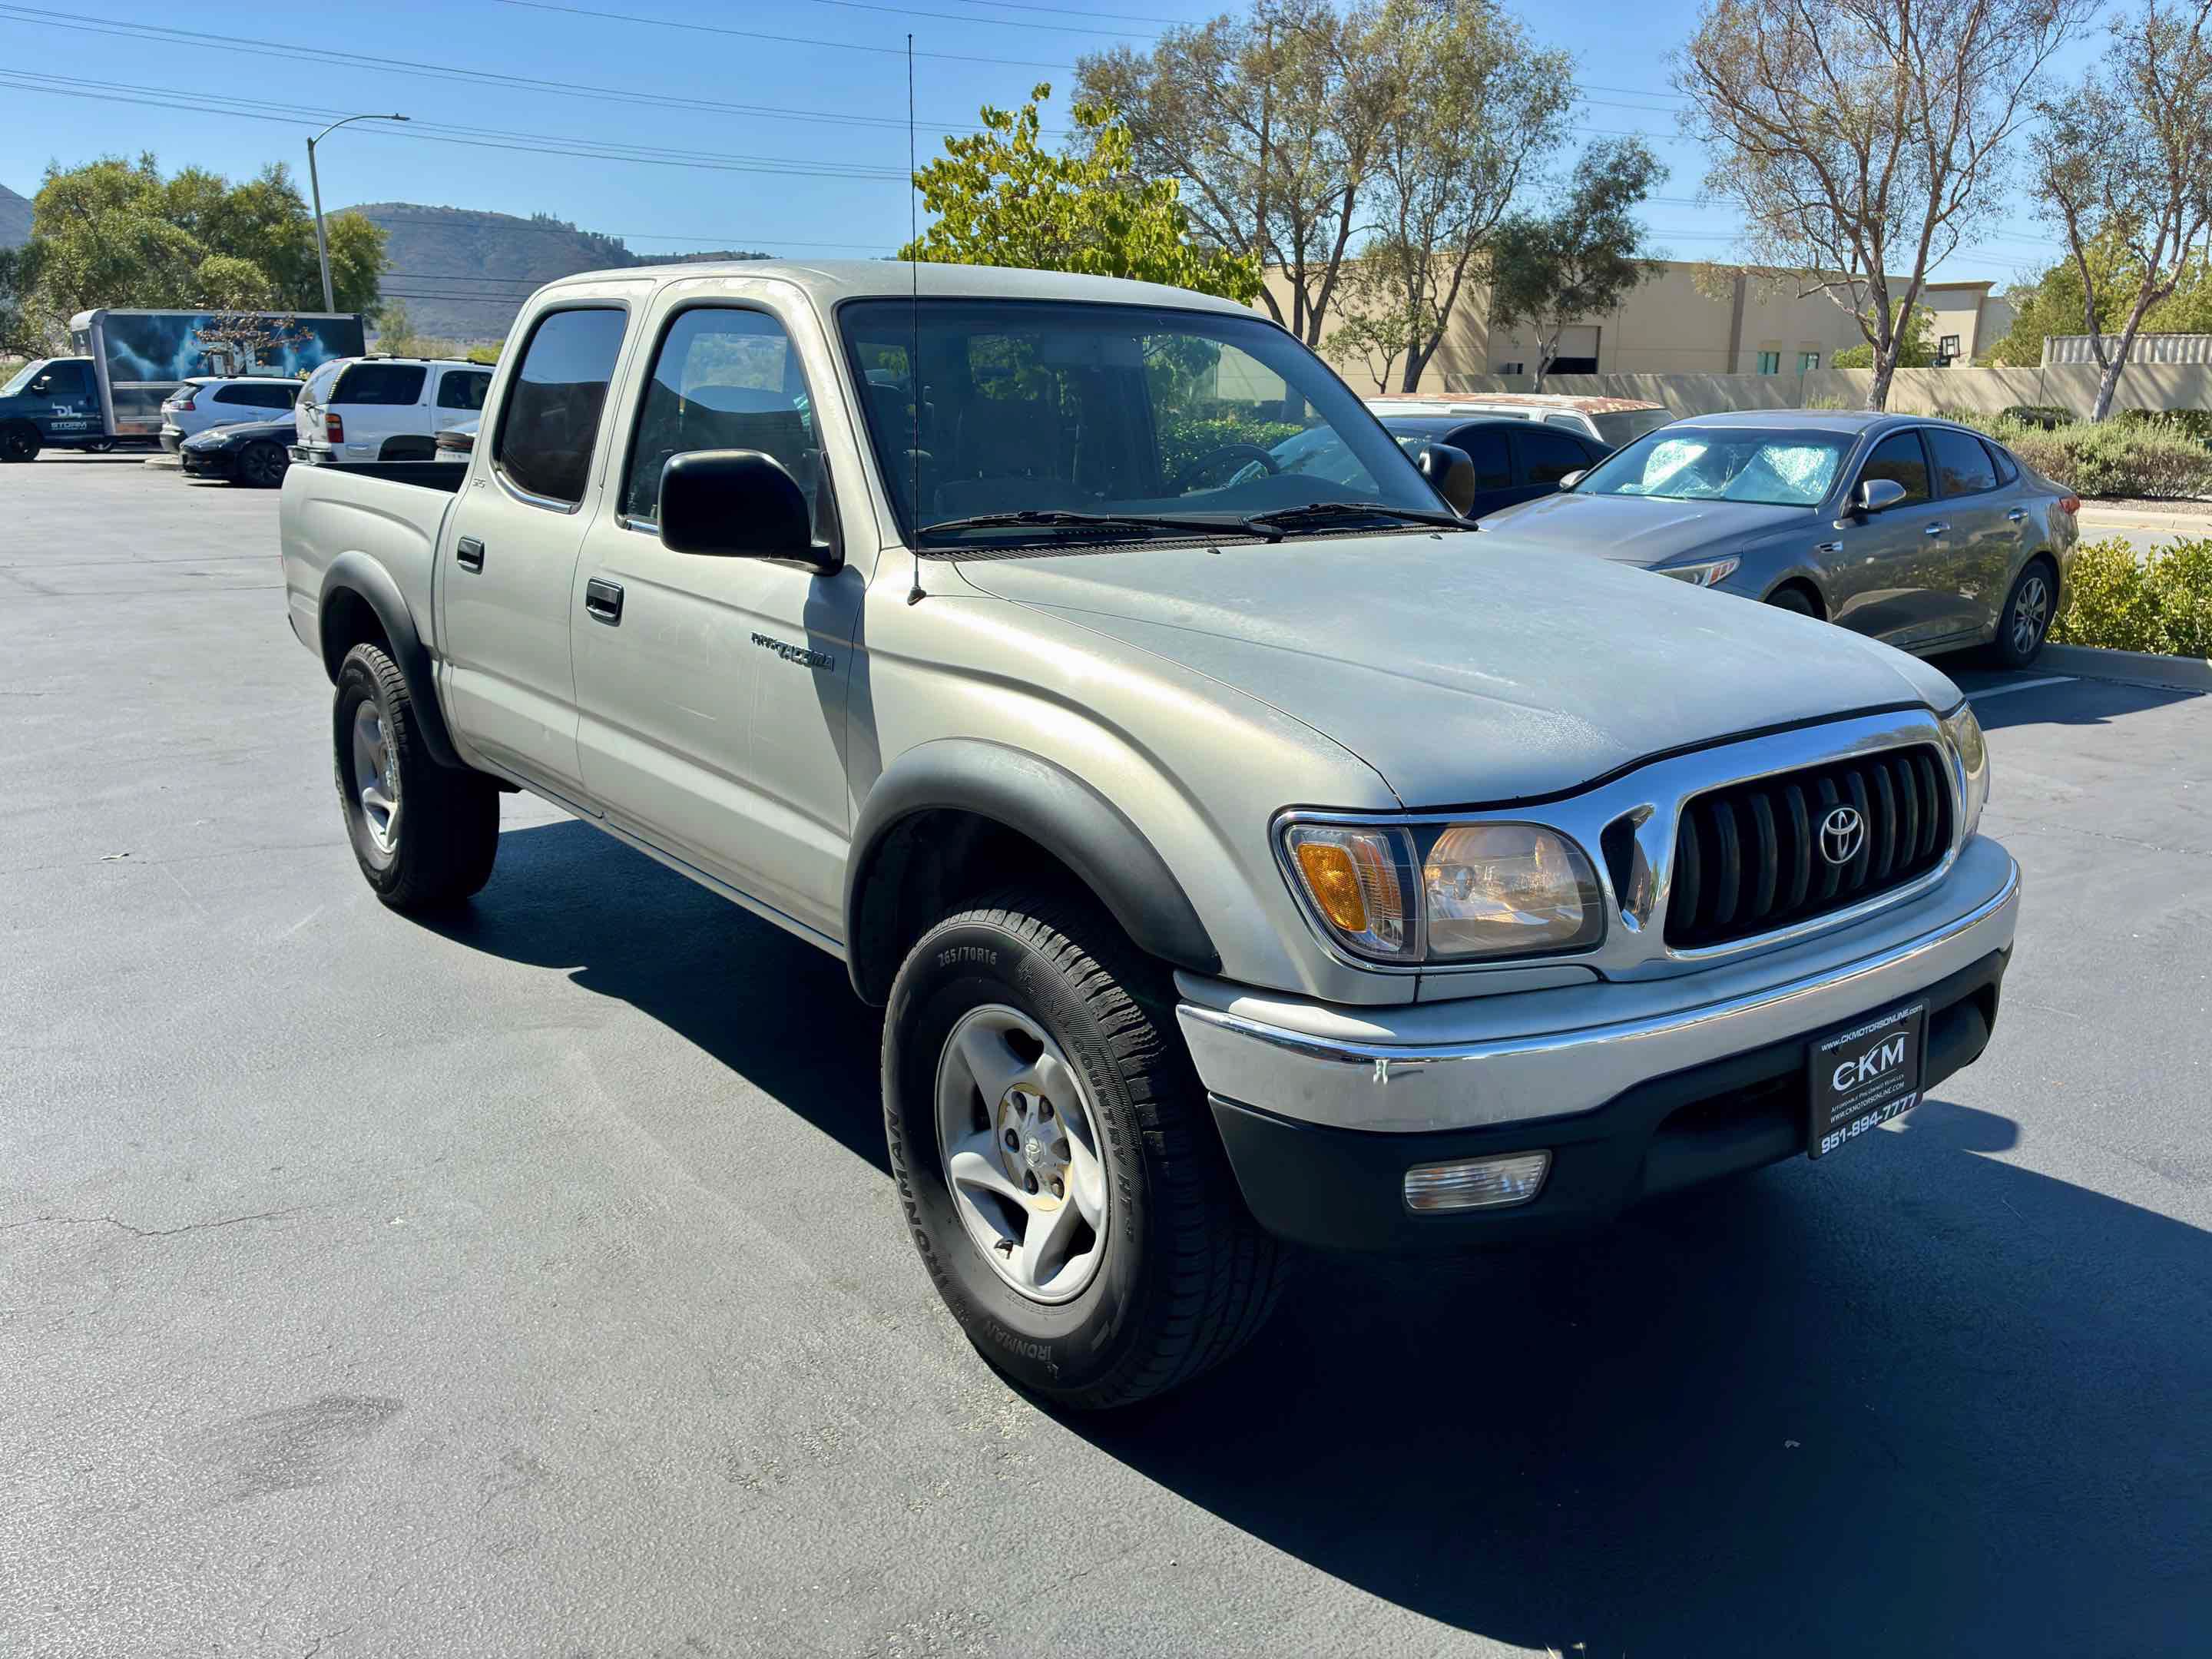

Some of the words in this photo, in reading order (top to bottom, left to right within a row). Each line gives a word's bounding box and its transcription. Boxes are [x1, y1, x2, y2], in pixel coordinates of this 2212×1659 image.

[1821, 1004, 1923, 1051] www.CKMOTORSONLINE.com
[1832, 1037, 1905, 1091] CKM
[1821, 1093, 1917, 1154] 951-894-7777
